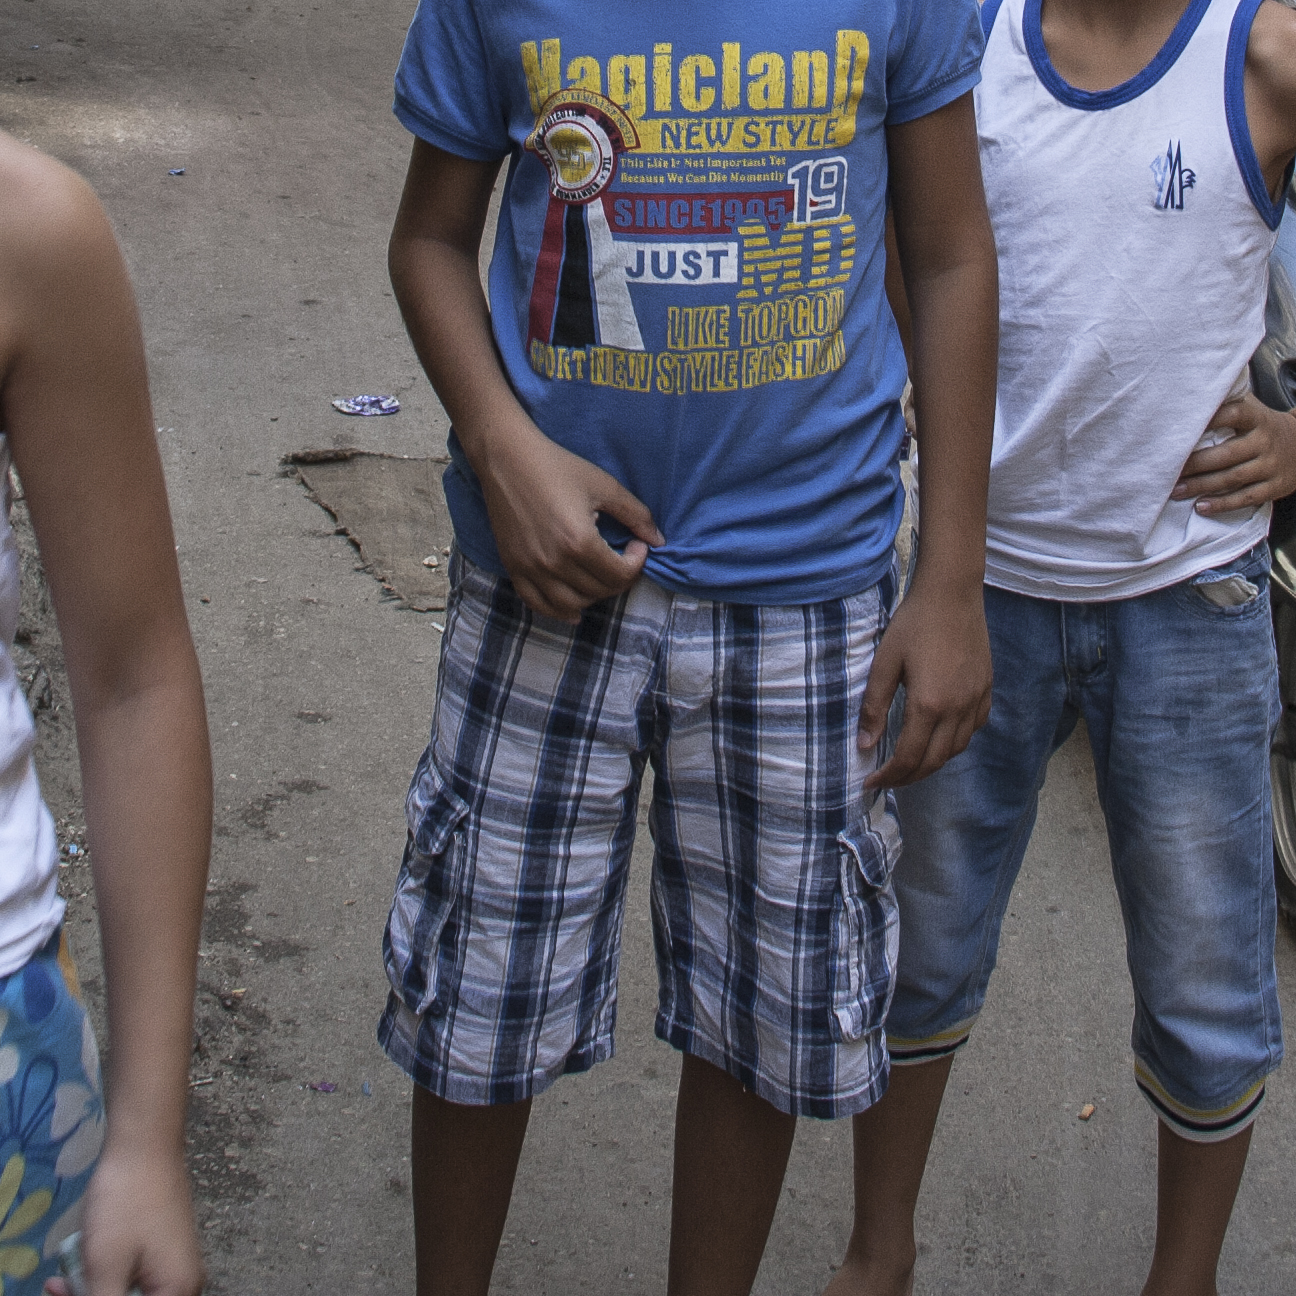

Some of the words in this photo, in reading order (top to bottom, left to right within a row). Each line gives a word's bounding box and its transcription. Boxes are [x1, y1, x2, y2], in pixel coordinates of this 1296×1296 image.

[660, 120, 734, 150] NEW
[743, 118, 839, 149] STYLE
[620, 157, 644, 168] This
[707, 156, 767, 170] Important
[620, 172, 665, 184] Because
[666, 173, 684, 184] We
[685, 172, 706, 183] Can
[708, 171, 728, 183] Die
[787, 156, 849, 225] 19
[625, 249, 729, 281] JUST
[590, 346, 653, 393] NEW
[655, 350, 739, 395] STYLE
